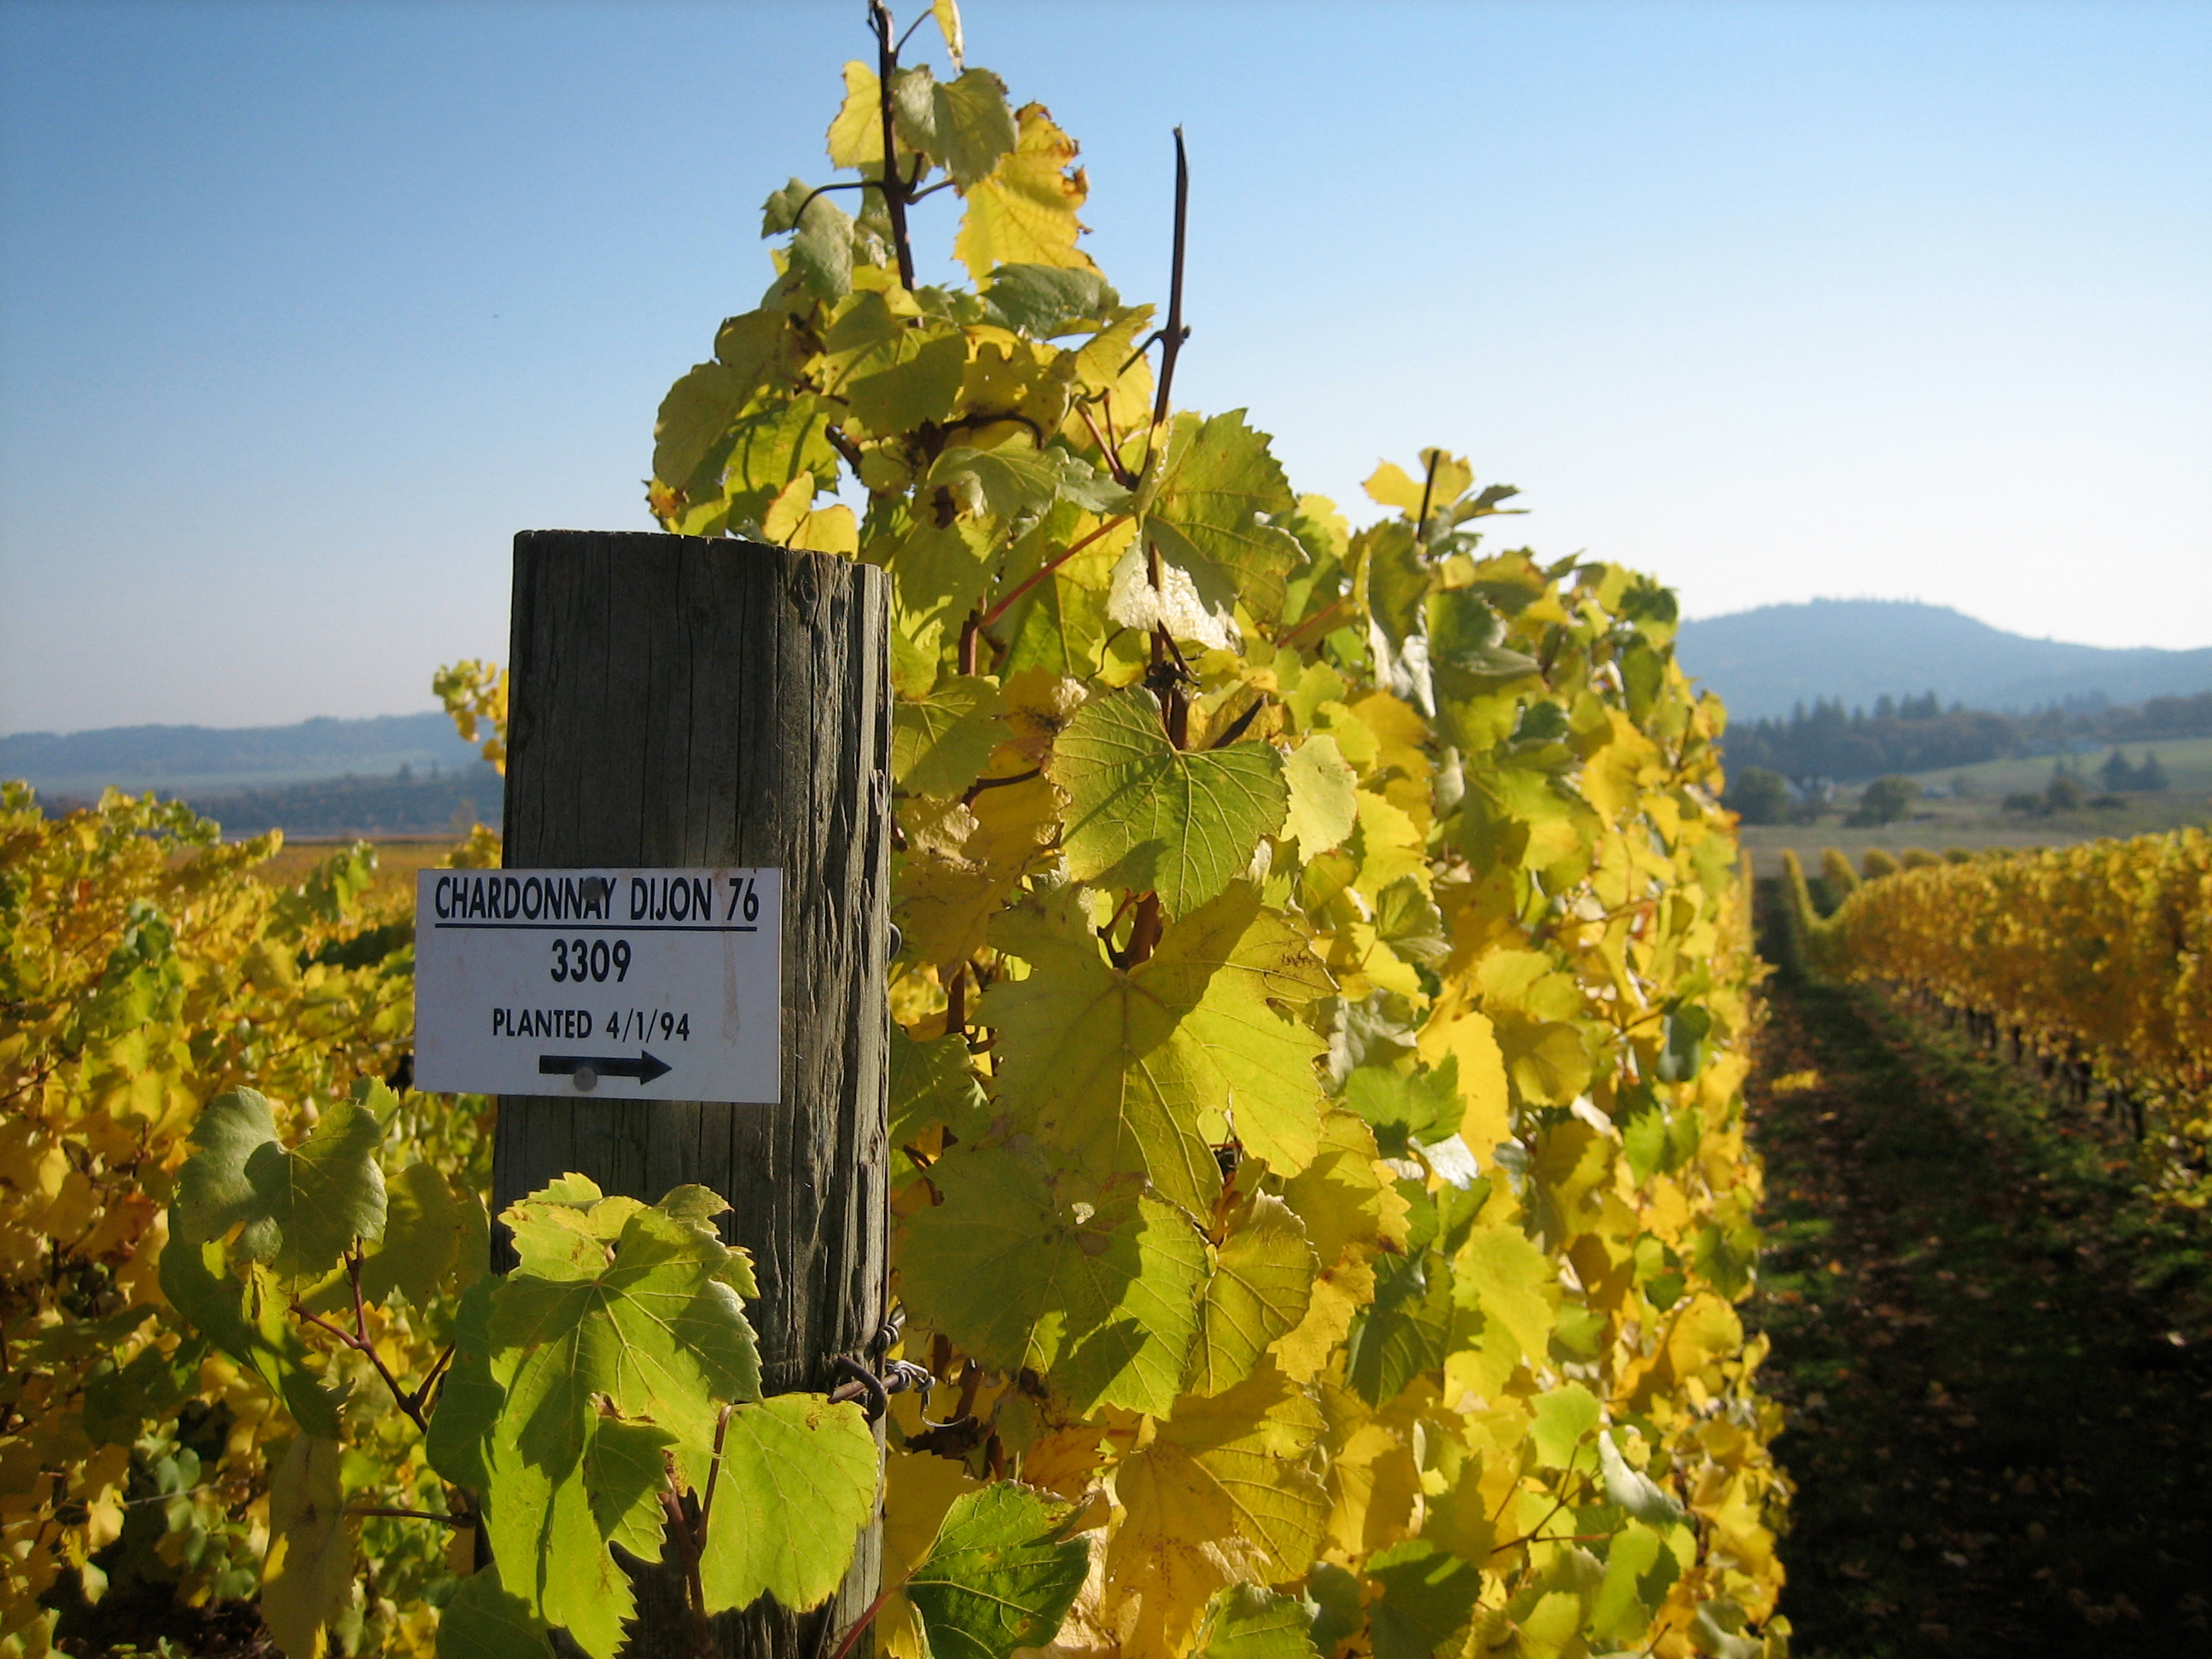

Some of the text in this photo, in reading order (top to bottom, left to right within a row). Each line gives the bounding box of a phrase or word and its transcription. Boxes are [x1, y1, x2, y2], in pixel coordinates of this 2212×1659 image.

[631, 877, 712, 921] DIJON
[726, 877, 760, 922] 76
[550, 939, 632, 982] 3309
[492, 1008, 690, 1043] PLANTED 4/1/94
